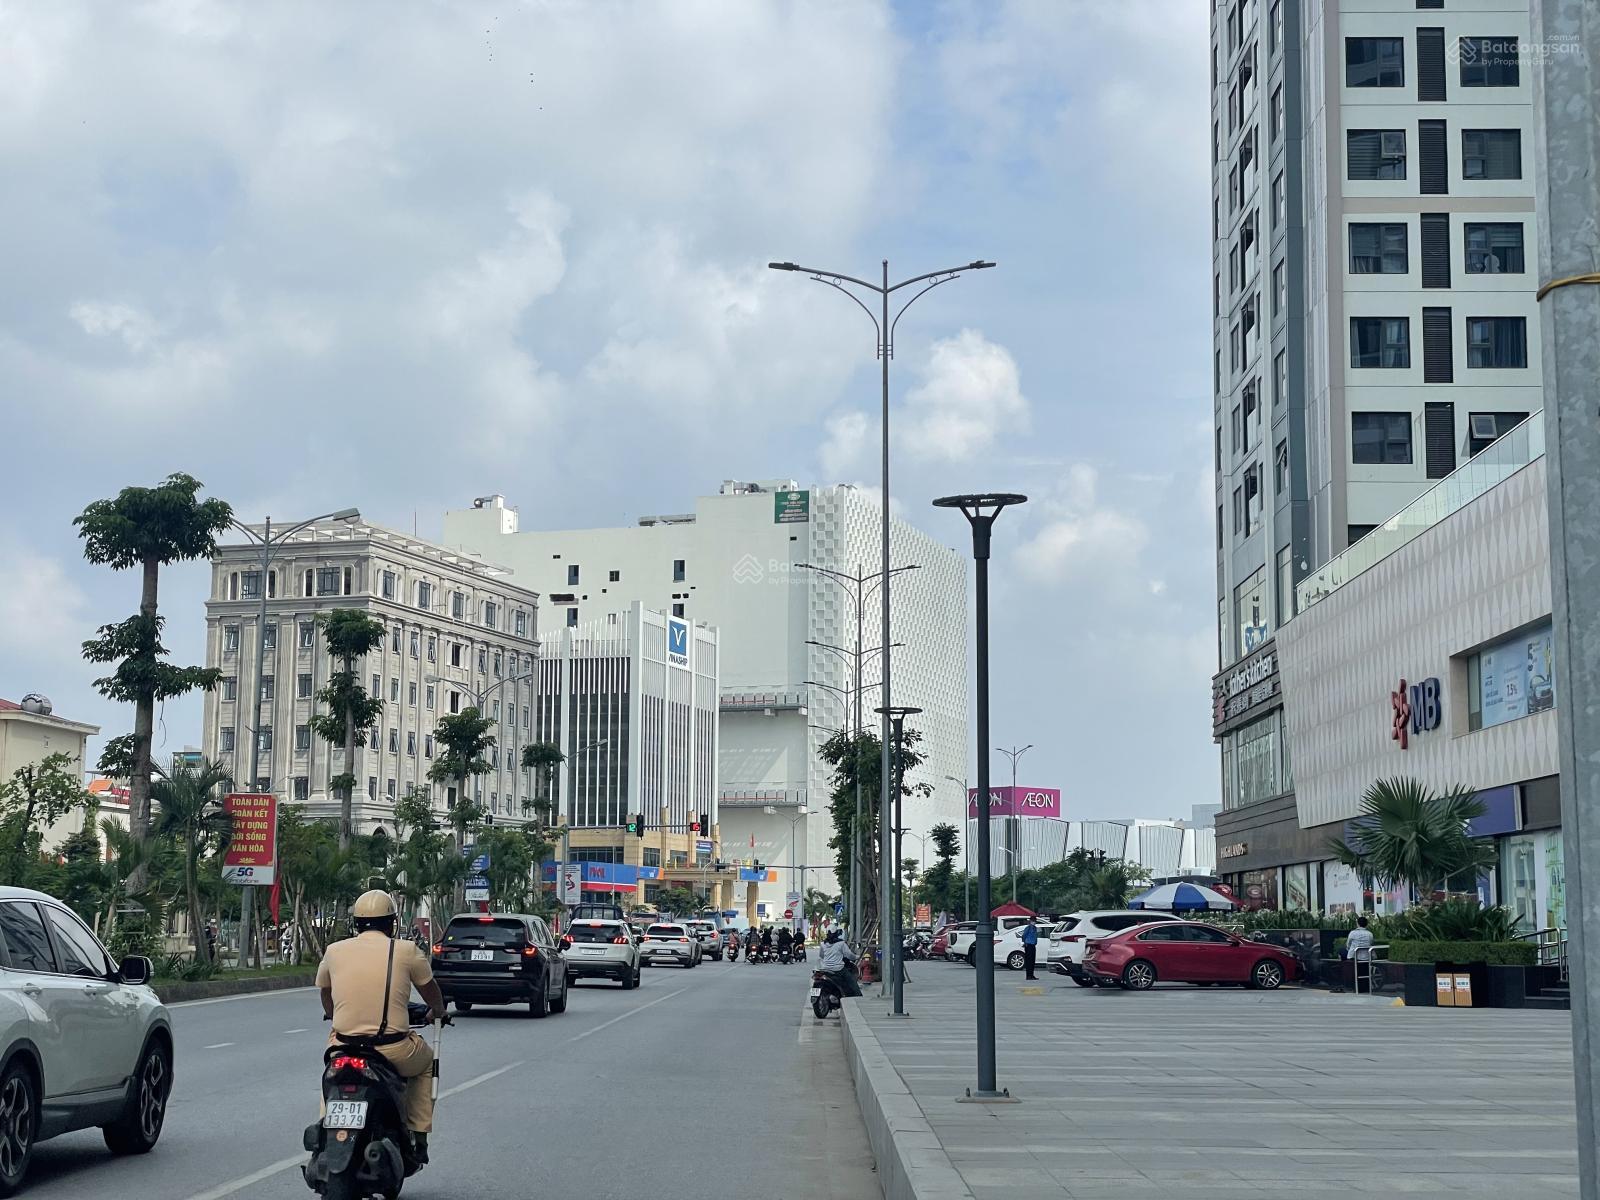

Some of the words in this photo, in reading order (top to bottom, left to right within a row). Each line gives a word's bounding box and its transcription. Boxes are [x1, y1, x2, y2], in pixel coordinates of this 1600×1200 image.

[1410, 677, 1442, 735] MB
[232, 797, 252, 806] TOÀN
[253, 797, 269, 806] DÂN
[254, 808, 268, 818] KẾT
[246, 831, 266, 841] SỐNG
[237, 867, 254, 877] 5G
[331, 1102, 362, 1114] 29-D1
[327, 1115, 363, 1126] 133.79
